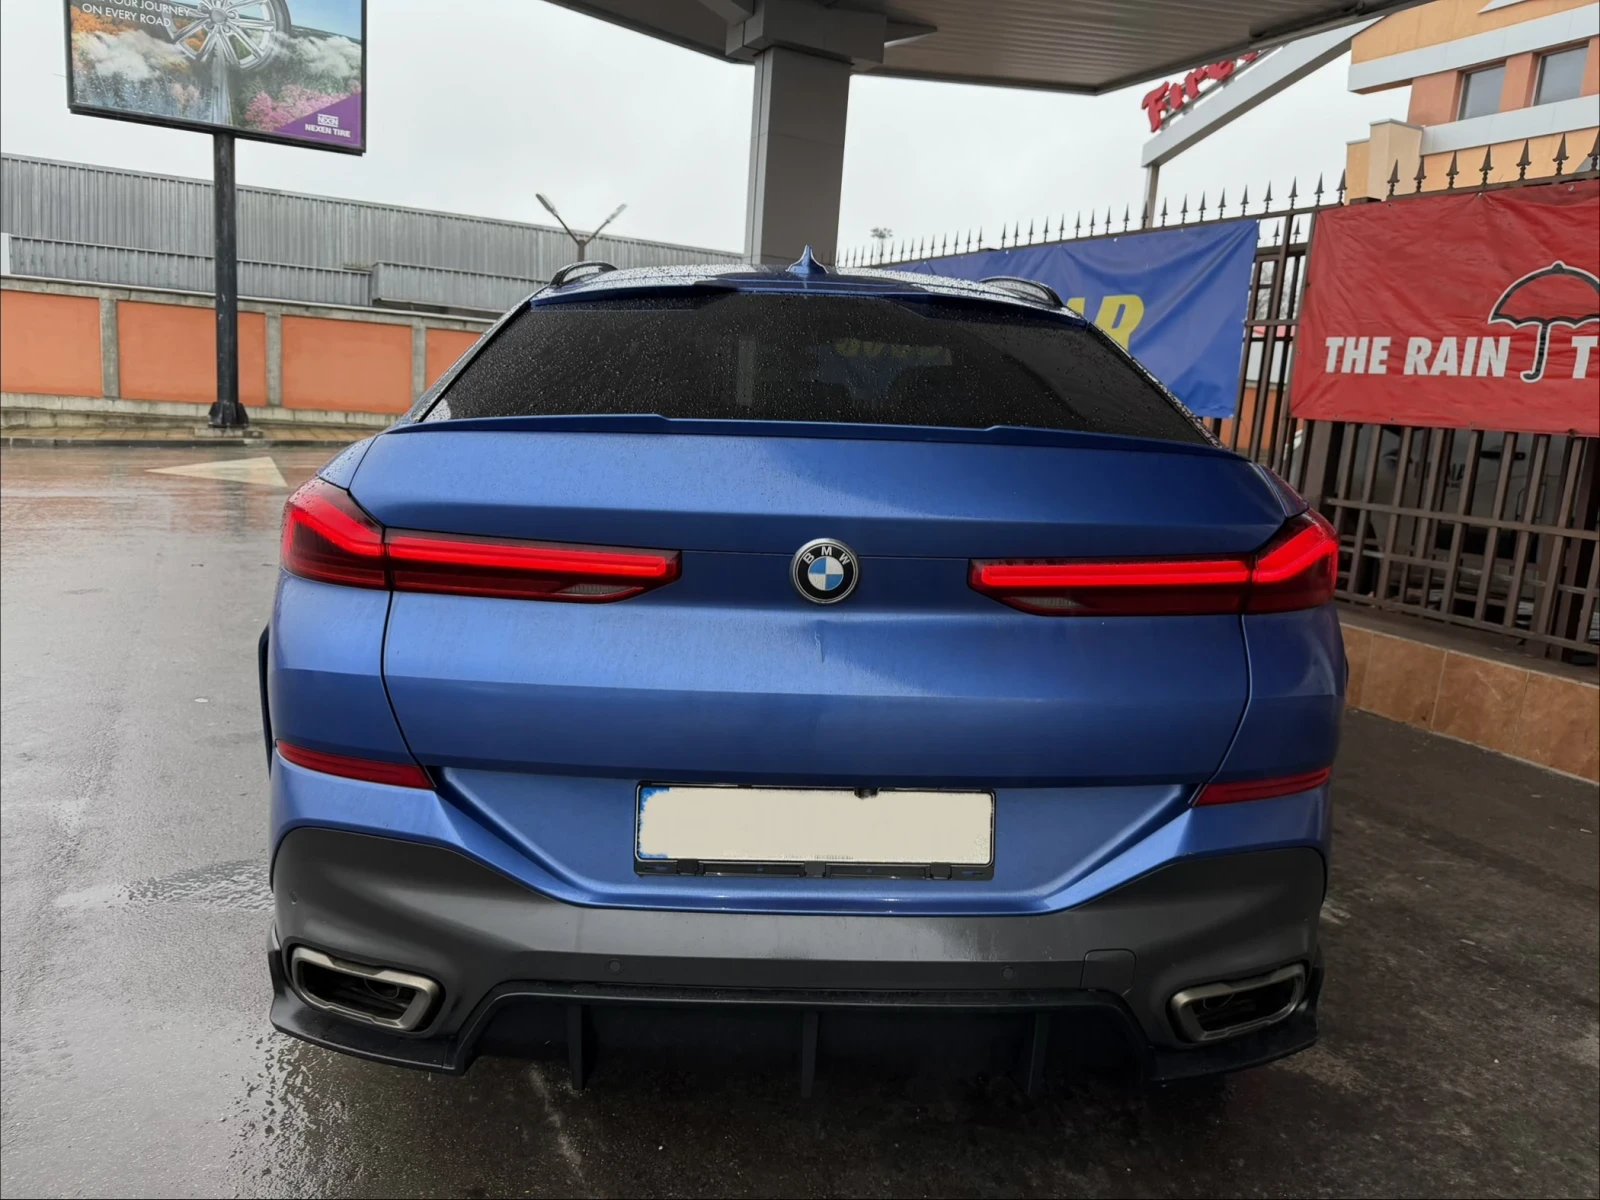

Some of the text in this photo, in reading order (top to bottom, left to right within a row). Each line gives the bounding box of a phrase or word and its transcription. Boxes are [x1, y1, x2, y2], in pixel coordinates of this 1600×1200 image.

[82, 3, 171, 27] ON EVERY ROAD
[140, 0, 190, 17] JOURNEY
[305, 123, 351, 138] NEXEN TIRE
[1325, 336, 1391, 374] THE
[1403, 336, 1510, 377] RAIN
[803, 546, 850, 565] BMW
